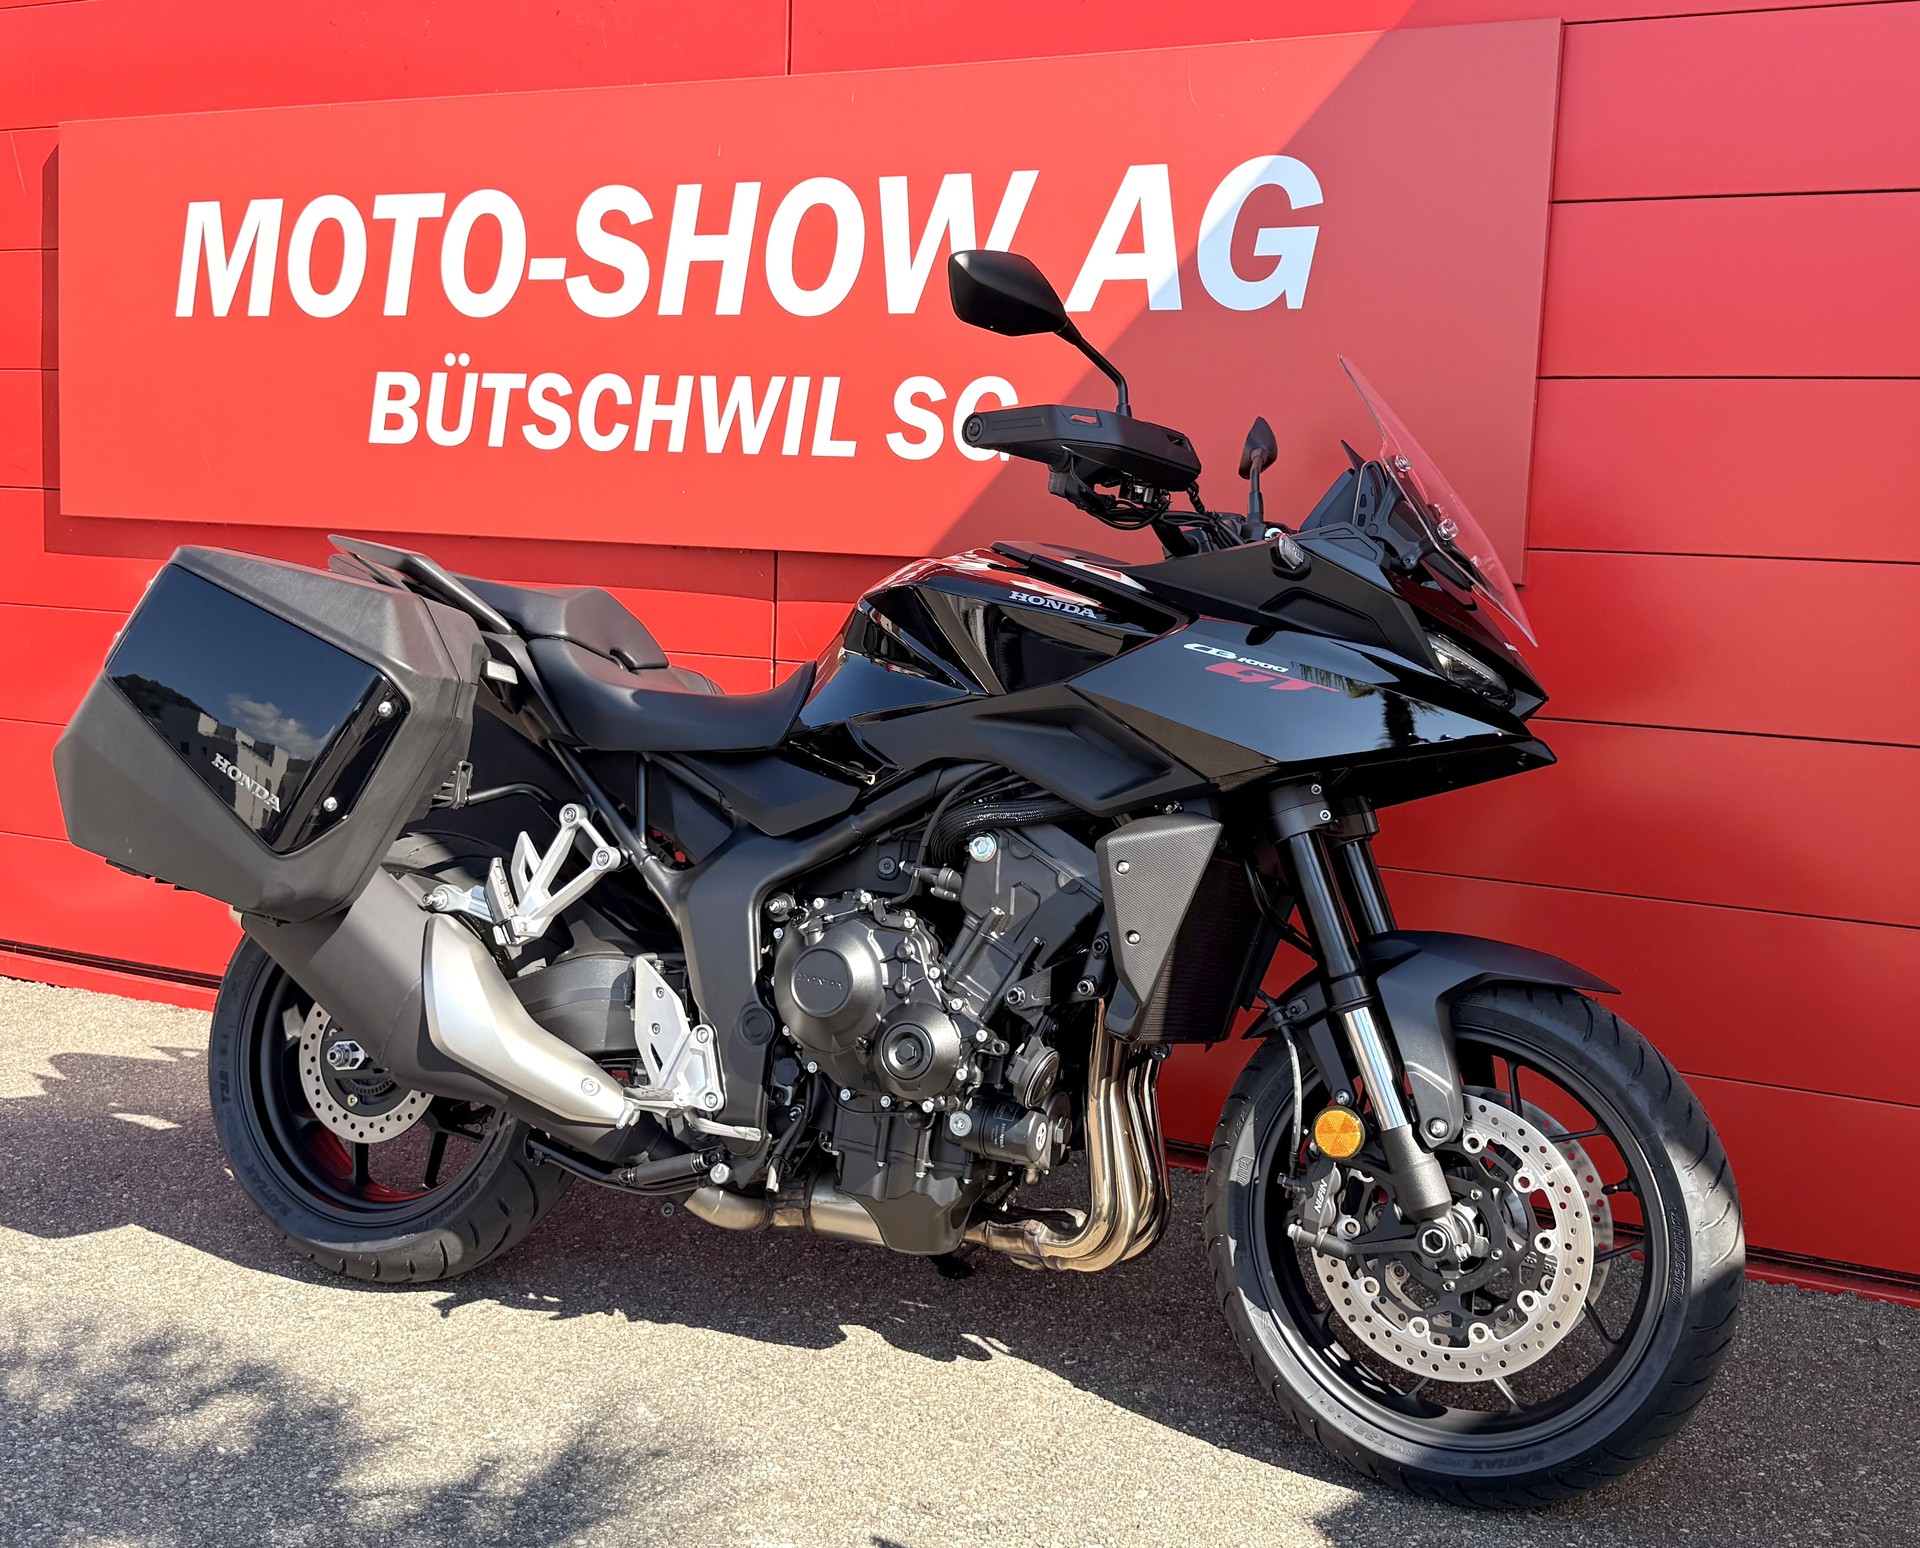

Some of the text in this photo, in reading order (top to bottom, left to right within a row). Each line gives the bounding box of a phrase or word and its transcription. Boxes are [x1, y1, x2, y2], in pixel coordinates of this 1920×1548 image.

[175, 154, 1324, 319] MOTO-SHOW AG
[368, 352, 857, 458] BÜTSCHWIL
[1009, 590, 1098, 619] HONDA
[1204, 661, 1342, 693] GT
[211, 752, 281, 813] HONDA
